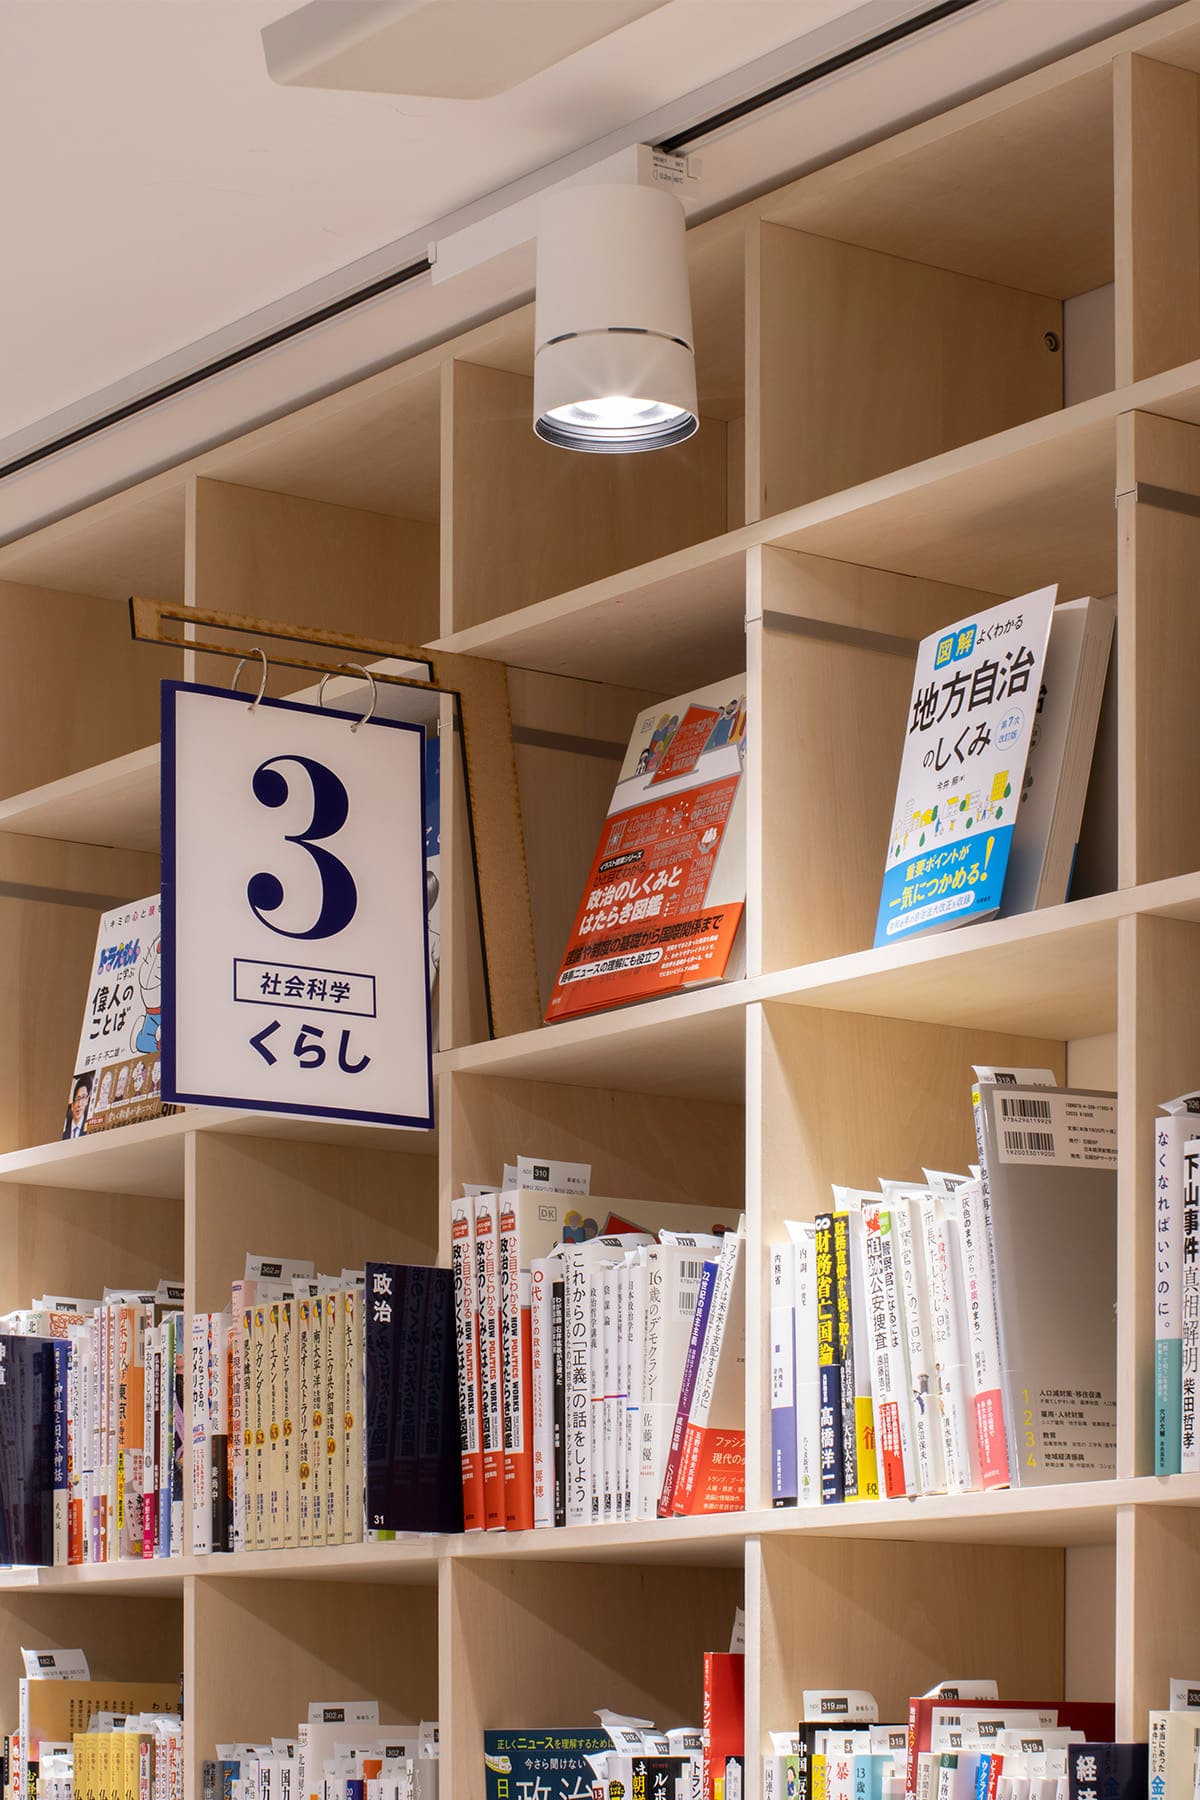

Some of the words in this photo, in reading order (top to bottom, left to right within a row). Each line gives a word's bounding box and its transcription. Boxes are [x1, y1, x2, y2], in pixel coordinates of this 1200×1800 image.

[936, 629, 974, 664] 図解
[976, 614, 1023, 645] よくわかる
[910, 646, 1035, 734] 地方自治
[922, 721, 991, 771] のしくみ
[247, 754, 358, 940] 3
[905, 843, 972, 882] 重要ポイントが
[586, 865, 683, 911] 政治のしくみと
[593, 861, 647, 888] ひと目でわかる
[109, 904, 161, 928] キミの心と頭
[578, 894, 664, 936] はたらき図鑑
[97, 936, 141, 976] ドラえもん
[92, 982, 135, 1016] 偉人の
[260, 972, 351, 1004] 社会科学
[89, 1005, 132, 1040] ことば
[249, 1020, 371, 1075] くらし
[534, 1169, 548, 1178] 310
[541, 1209, 555, 1218] DK
[1157, 1131, 1171, 1328] なくなればいいのに。
[1184, 1154, 1200, 1265] 下山事件
[462, 1242, 473, 1319] ひと目でわかる
[485, 1239, 496, 1316] ひと目でわかる
[508, 1236, 519, 1315] ひと目でわかる
[882, 1240, 899, 1347] 警察官になるには
[373, 1272, 393, 1324] 政治
[816, 1231, 835, 1365] 財務省亡国論
[488, 1319, 496, 1338] HOW
[647, 1270, 663, 1401] 16歳のデモクラシー
[1183, 1266, 1200, 1375] 真相解明
[466, 1343, 474, 1382] POLITICS
[489, 1340, 497, 1380] POLITICS
[511, 1339, 519, 1379] POLITICS
[572, 1252, 587, 1503] これからの「正義」の話をしよう
[467, 1384, 475, 1415] WORKS
[490, 1382, 498, 1413] WORKS
[512, 1381, 520, 1412] WORKS
[1022, 1388, 1030, 1406] 1
[1183, 1378, 1195, 1449] 柴田哲孝
[1023, 1409, 1034, 1426] 2
[1024, 1431, 1035, 1448] 3
[1026, 1451, 1037, 1467] 4
[374, 1514, 385, 1526] 31
[890, 1737, 904, 1746] 319
[524, 1757, 586, 1770] 今さら聞けない
[1151, 1775, 1166, 1800] 金
